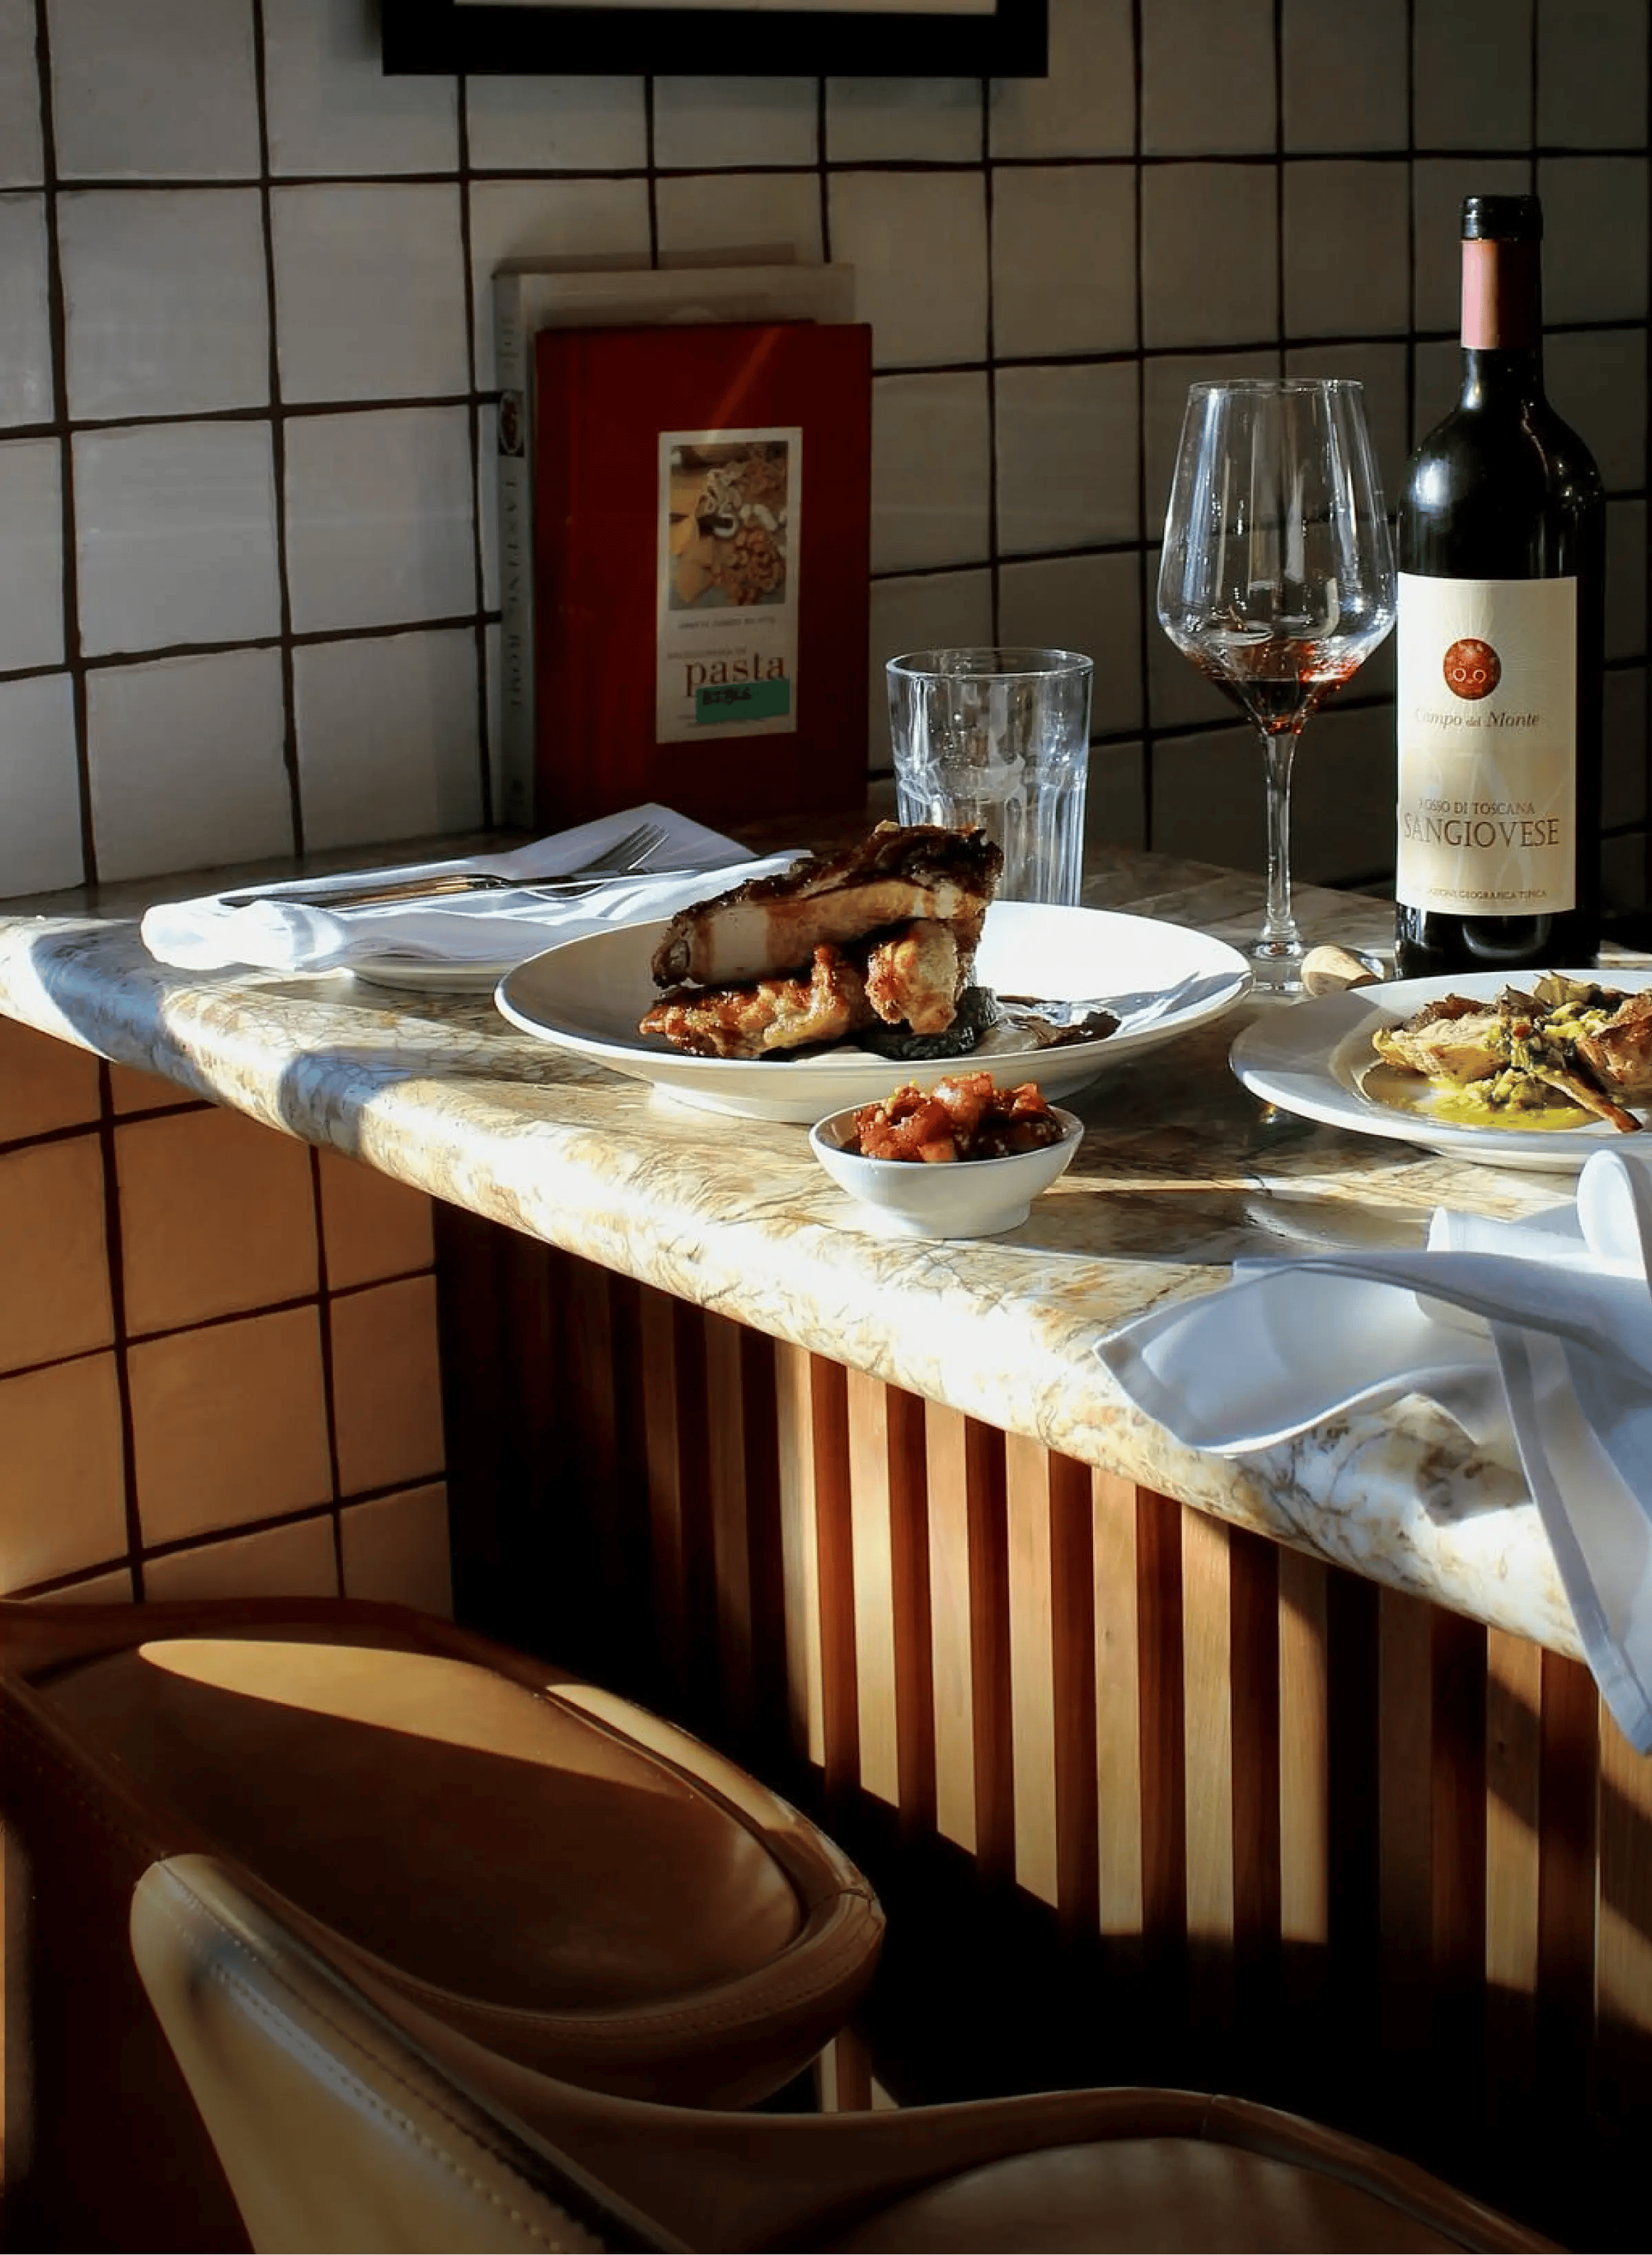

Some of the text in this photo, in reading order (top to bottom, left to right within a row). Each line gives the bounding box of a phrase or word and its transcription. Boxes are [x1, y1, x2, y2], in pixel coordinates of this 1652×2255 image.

[682, 651, 785, 698] pasta
[1485, 711, 1540, 728] Monte
[1454, 802, 1468, 814] DI
[1472, 802, 1536, 816] TOSCANA
[1404, 812, 1560, 848] SANGIOVESE
